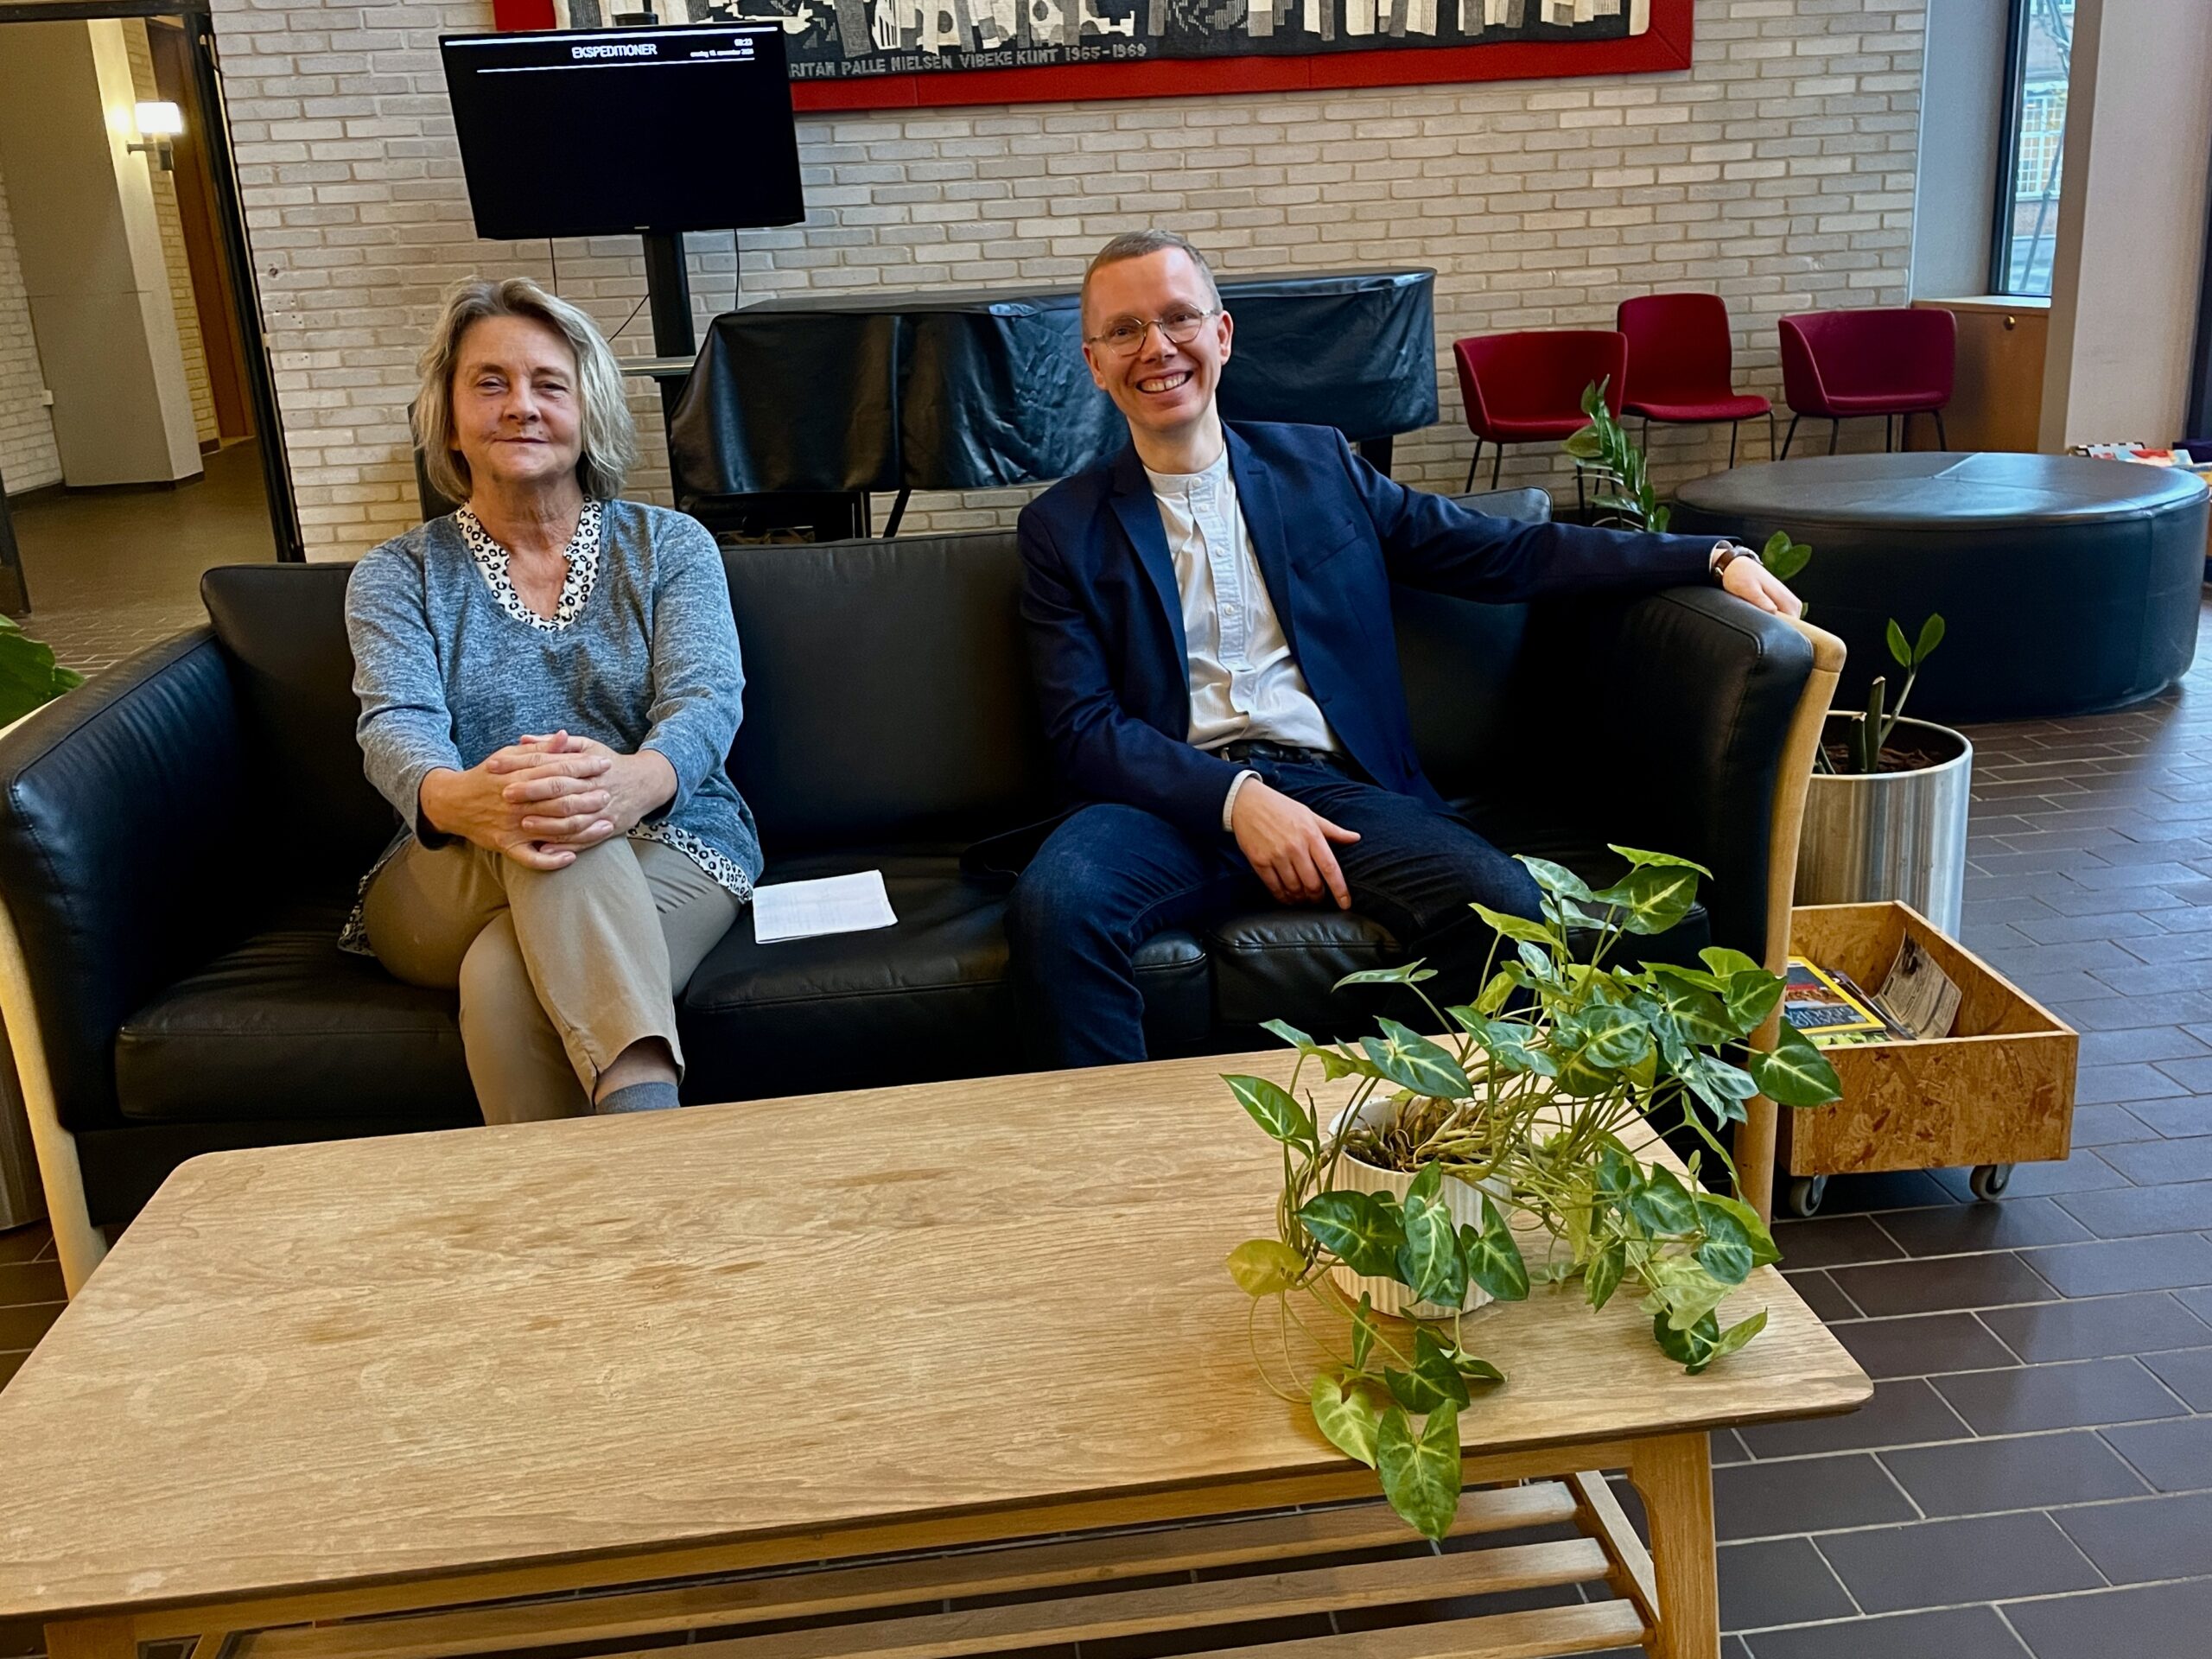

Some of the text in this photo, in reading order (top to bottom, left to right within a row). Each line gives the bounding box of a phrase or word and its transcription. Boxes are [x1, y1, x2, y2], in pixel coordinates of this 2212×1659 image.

[571, 43, 658, 59] EKSPEDITIONER
[841, 58, 886, 76] PALLE
[891, 54, 952, 72] NIELSEN
[958, 51, 1013, 69] VIBEKE
